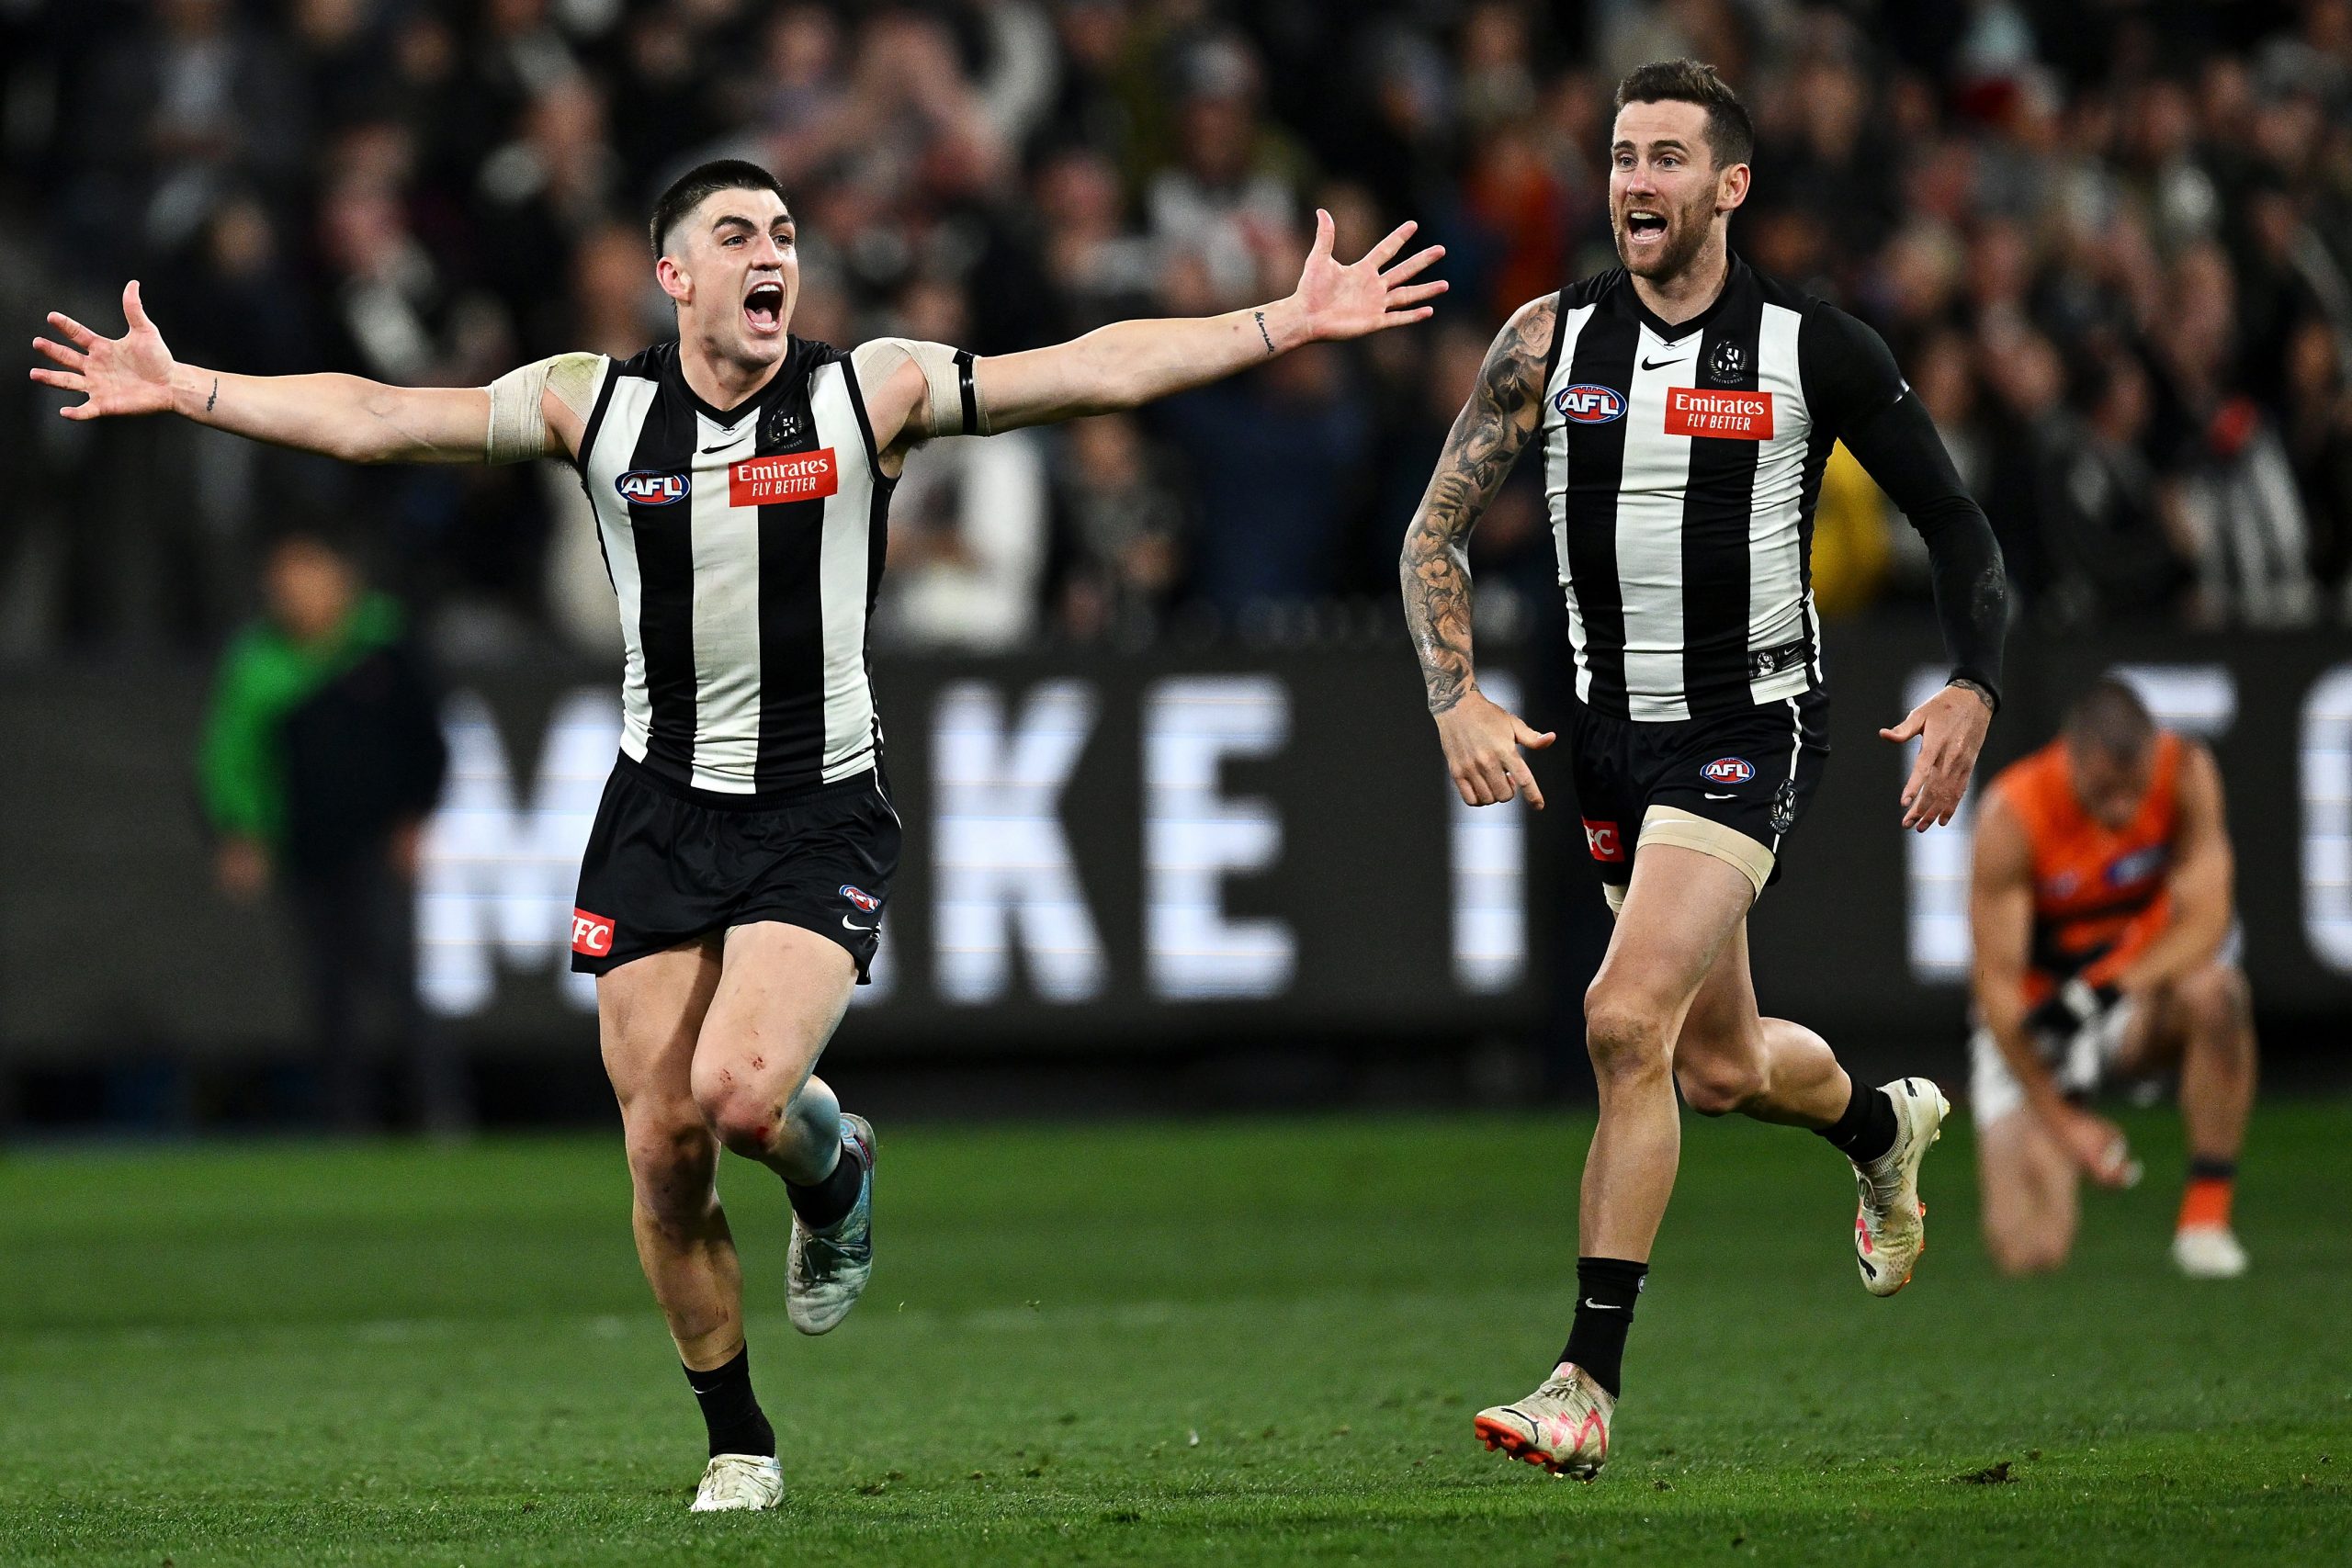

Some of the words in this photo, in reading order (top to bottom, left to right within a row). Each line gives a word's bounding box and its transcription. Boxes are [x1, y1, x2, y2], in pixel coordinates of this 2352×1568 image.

[1559, 393, 1619, 415] AFL
[1675, 393, 1765, 415] Emirates
[1687, 413, 1706, 428] FLY
[1709, 415, 1751, 431] BETTER
[738, 458, 829, 482] Emirates
[621, 477, 683, 496] AFL
[752, 481, 771, 497] FLY
[775, 477, 816, 495] BETTER
[1706, 763, 1750, 778] AFL
[416, 678, 1295, 1007] MKE
[572, 915, 609, 950] FC
